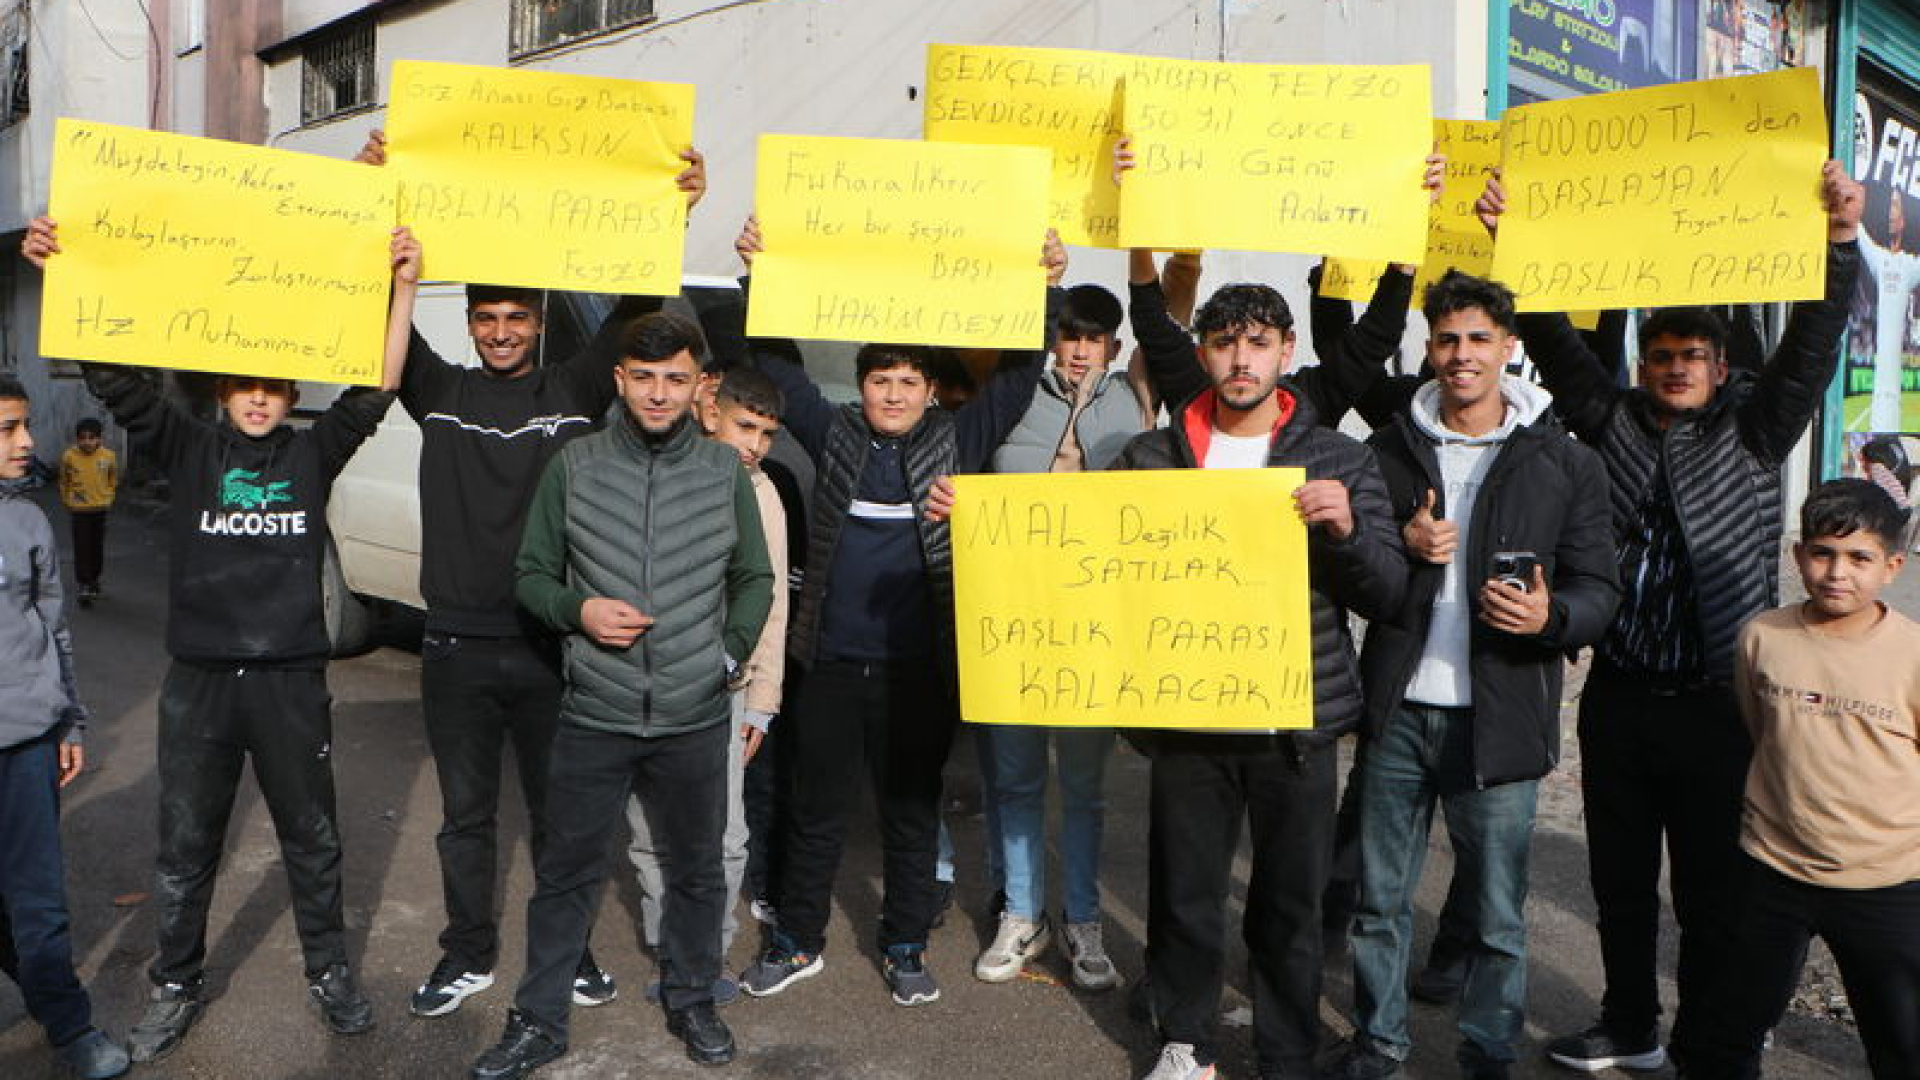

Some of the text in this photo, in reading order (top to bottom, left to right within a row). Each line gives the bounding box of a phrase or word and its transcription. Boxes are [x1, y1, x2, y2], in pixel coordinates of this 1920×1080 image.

[1134, 103, 1179, 134] 50
[1658, 103, 1714, 143] TL
[460, 121, 632, 158] KALKSIN
[199, 509, 307, 535] LACOSTE
[967, 497, 1085, 549] MAL
[1146, 615, 1287, 652] PARASI
